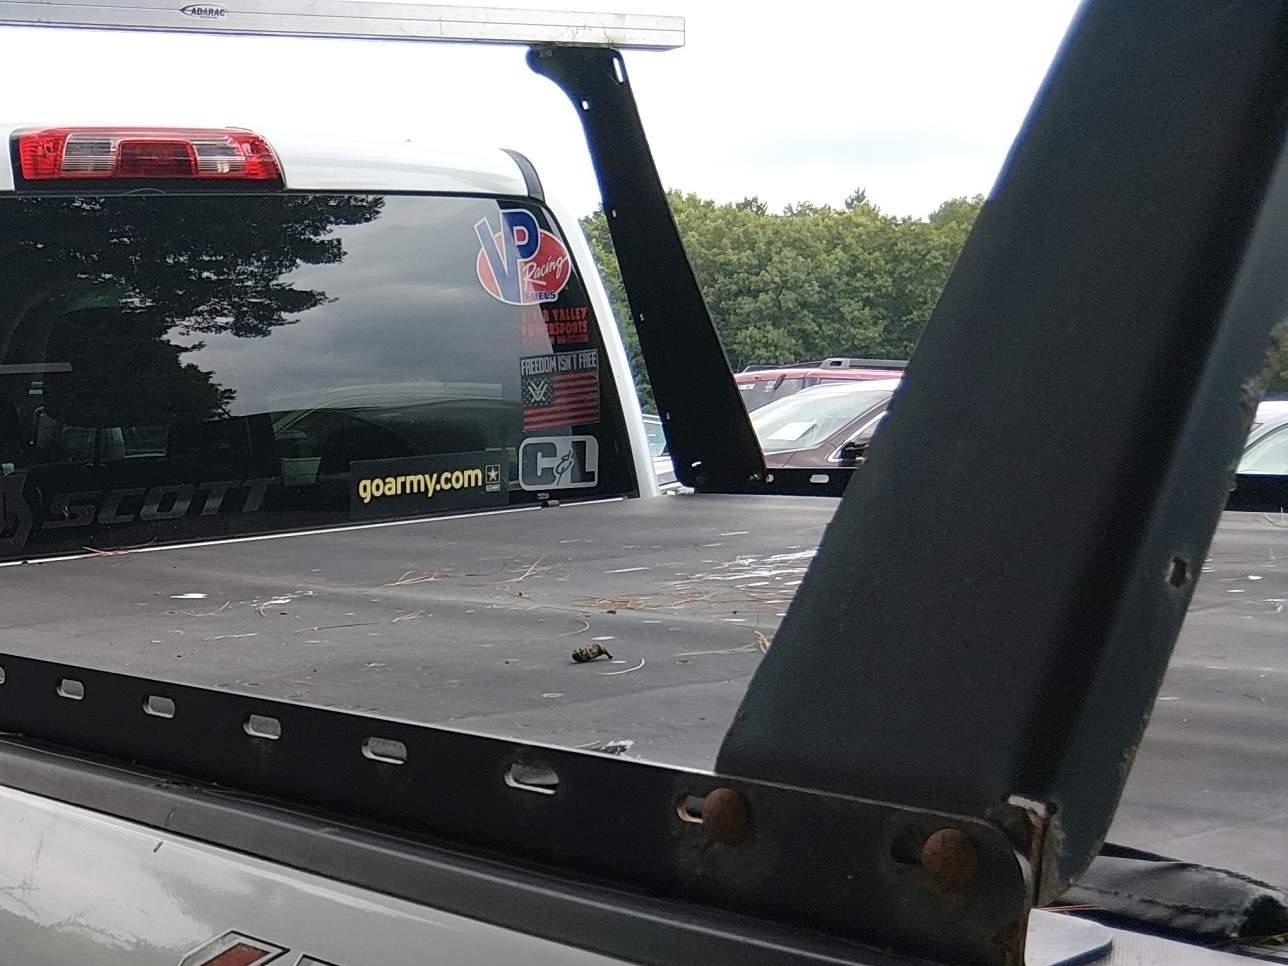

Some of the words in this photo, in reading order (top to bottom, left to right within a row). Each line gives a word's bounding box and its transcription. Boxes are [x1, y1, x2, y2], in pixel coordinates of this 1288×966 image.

[523, 256, 569, 291] Racing
[526, 290, 557, 300] FUELS
[552, 306, 587, 320] VALLEY
[520, 354, 557, 376] FREEDOM
[578, 351, 597, 369] FREE
[358, 468, 483, 504] goarmy.com
[41, 478, 281, 530] SCOTT
